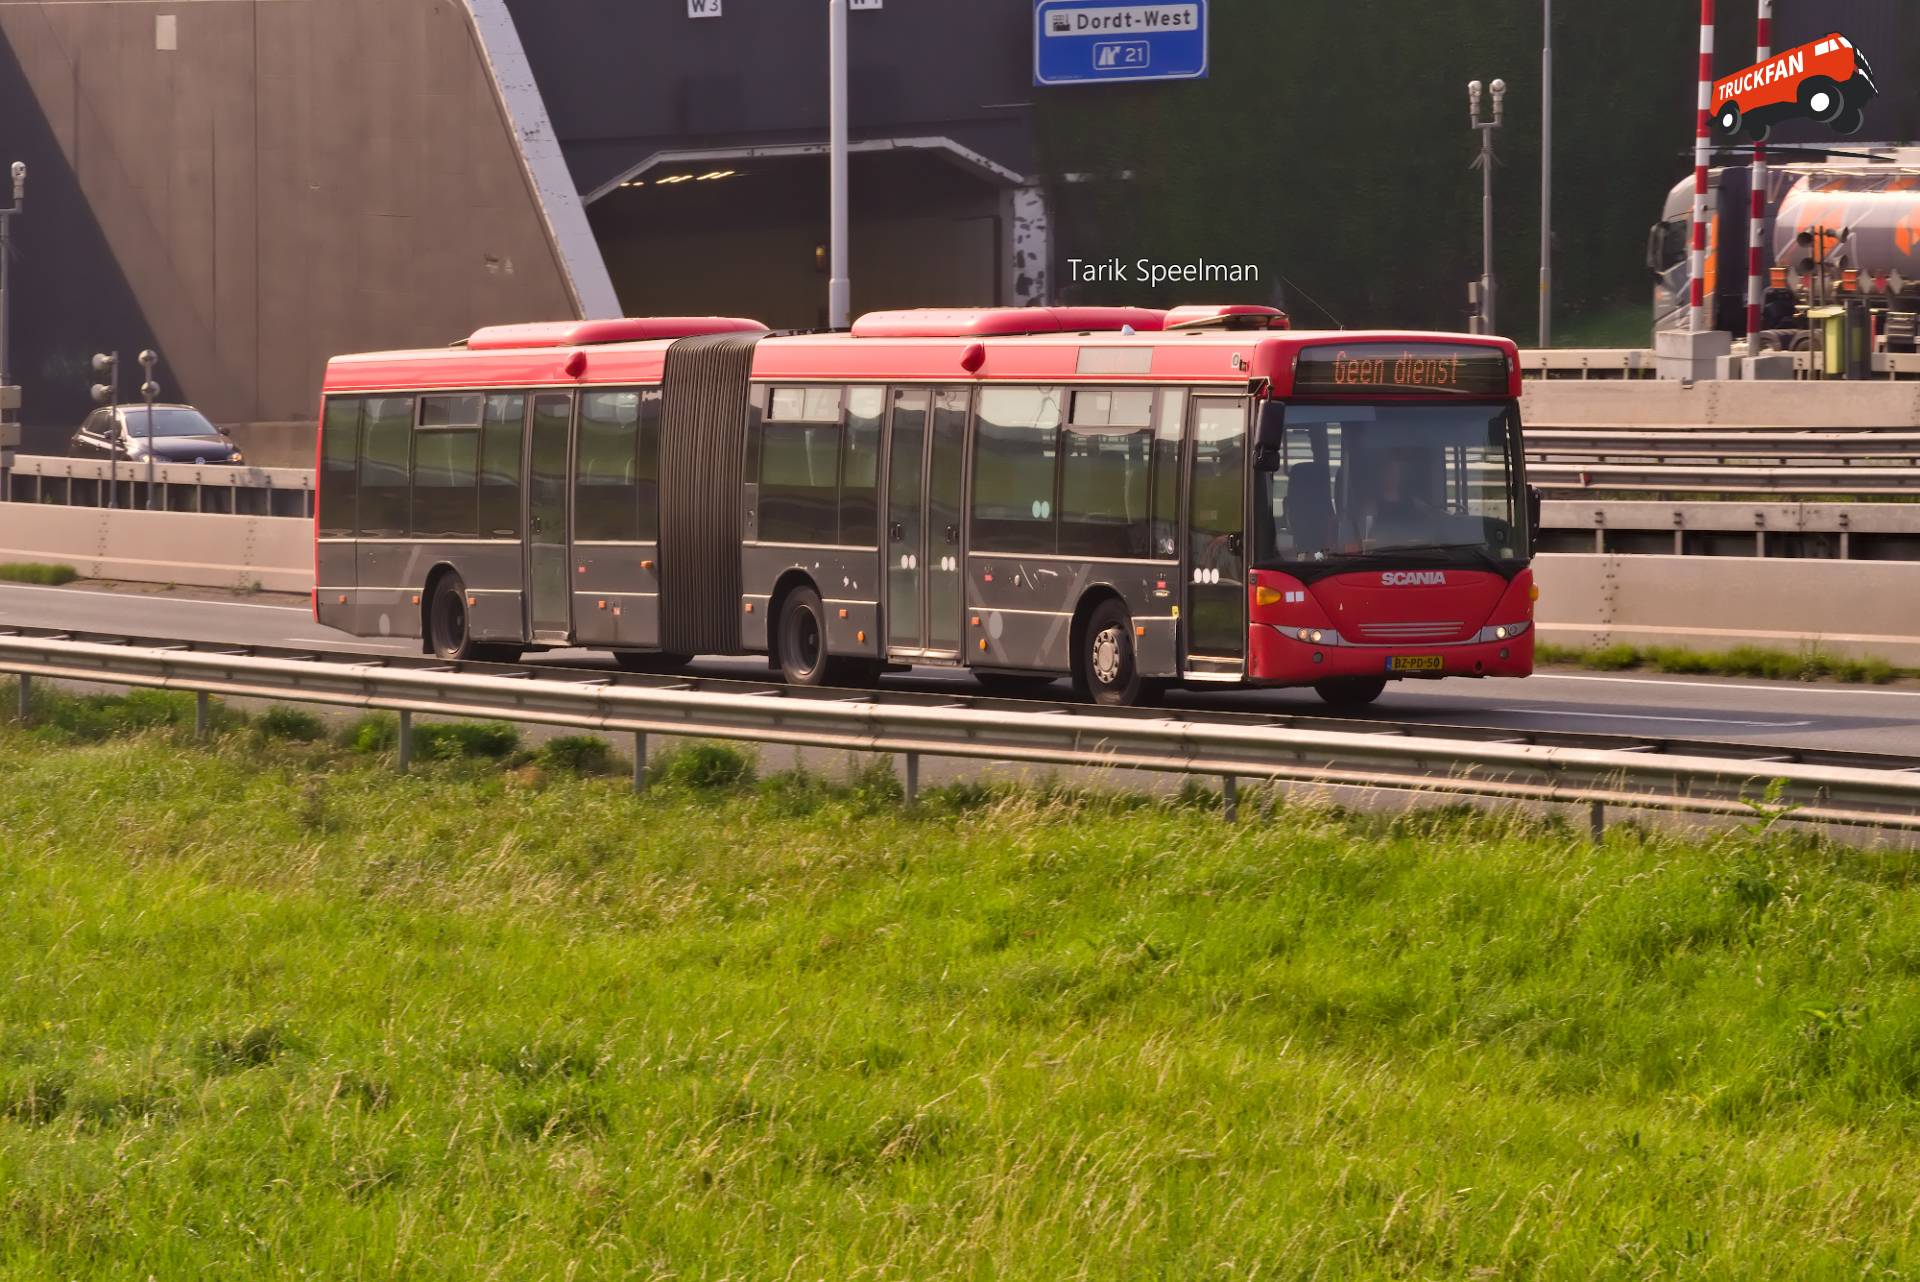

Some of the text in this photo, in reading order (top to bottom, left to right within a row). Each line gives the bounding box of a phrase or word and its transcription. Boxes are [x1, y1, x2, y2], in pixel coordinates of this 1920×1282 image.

[1077, 10, 1191, 30] Dordt-West
[1125, 47, 1143, 62] 21
[1333, 350, 1458, 384] Geen dienst
[1381, 571, 1447, 586] SCANIA
